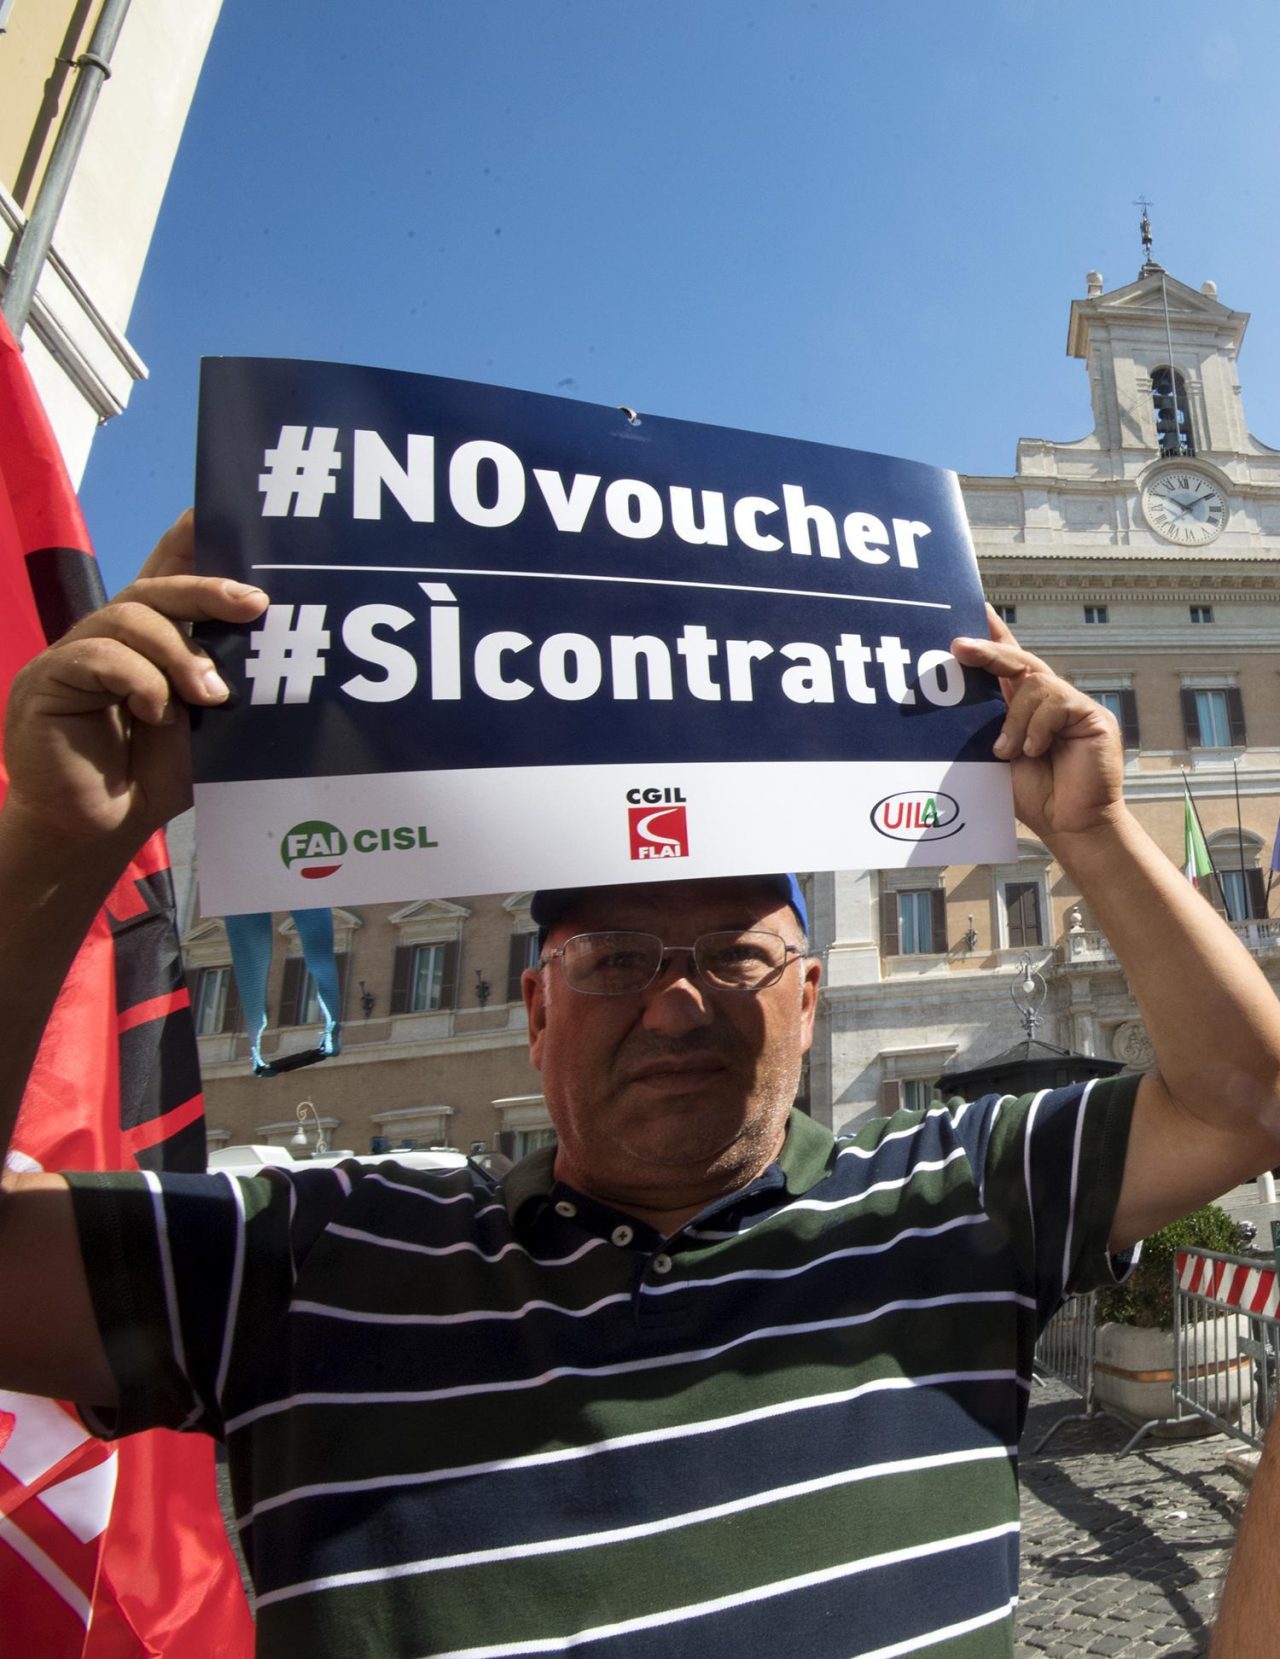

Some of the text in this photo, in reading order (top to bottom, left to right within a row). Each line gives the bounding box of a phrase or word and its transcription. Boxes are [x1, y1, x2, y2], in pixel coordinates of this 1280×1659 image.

[257, 424, 933, 570] #NOvoucher
[244, 581, 967, 707] #SÌcontratto
[626, 786, 688, 805] CGIL
[287, 825, 439, 858] FAI CISL
[638, 844, 682, 859] FLAI
